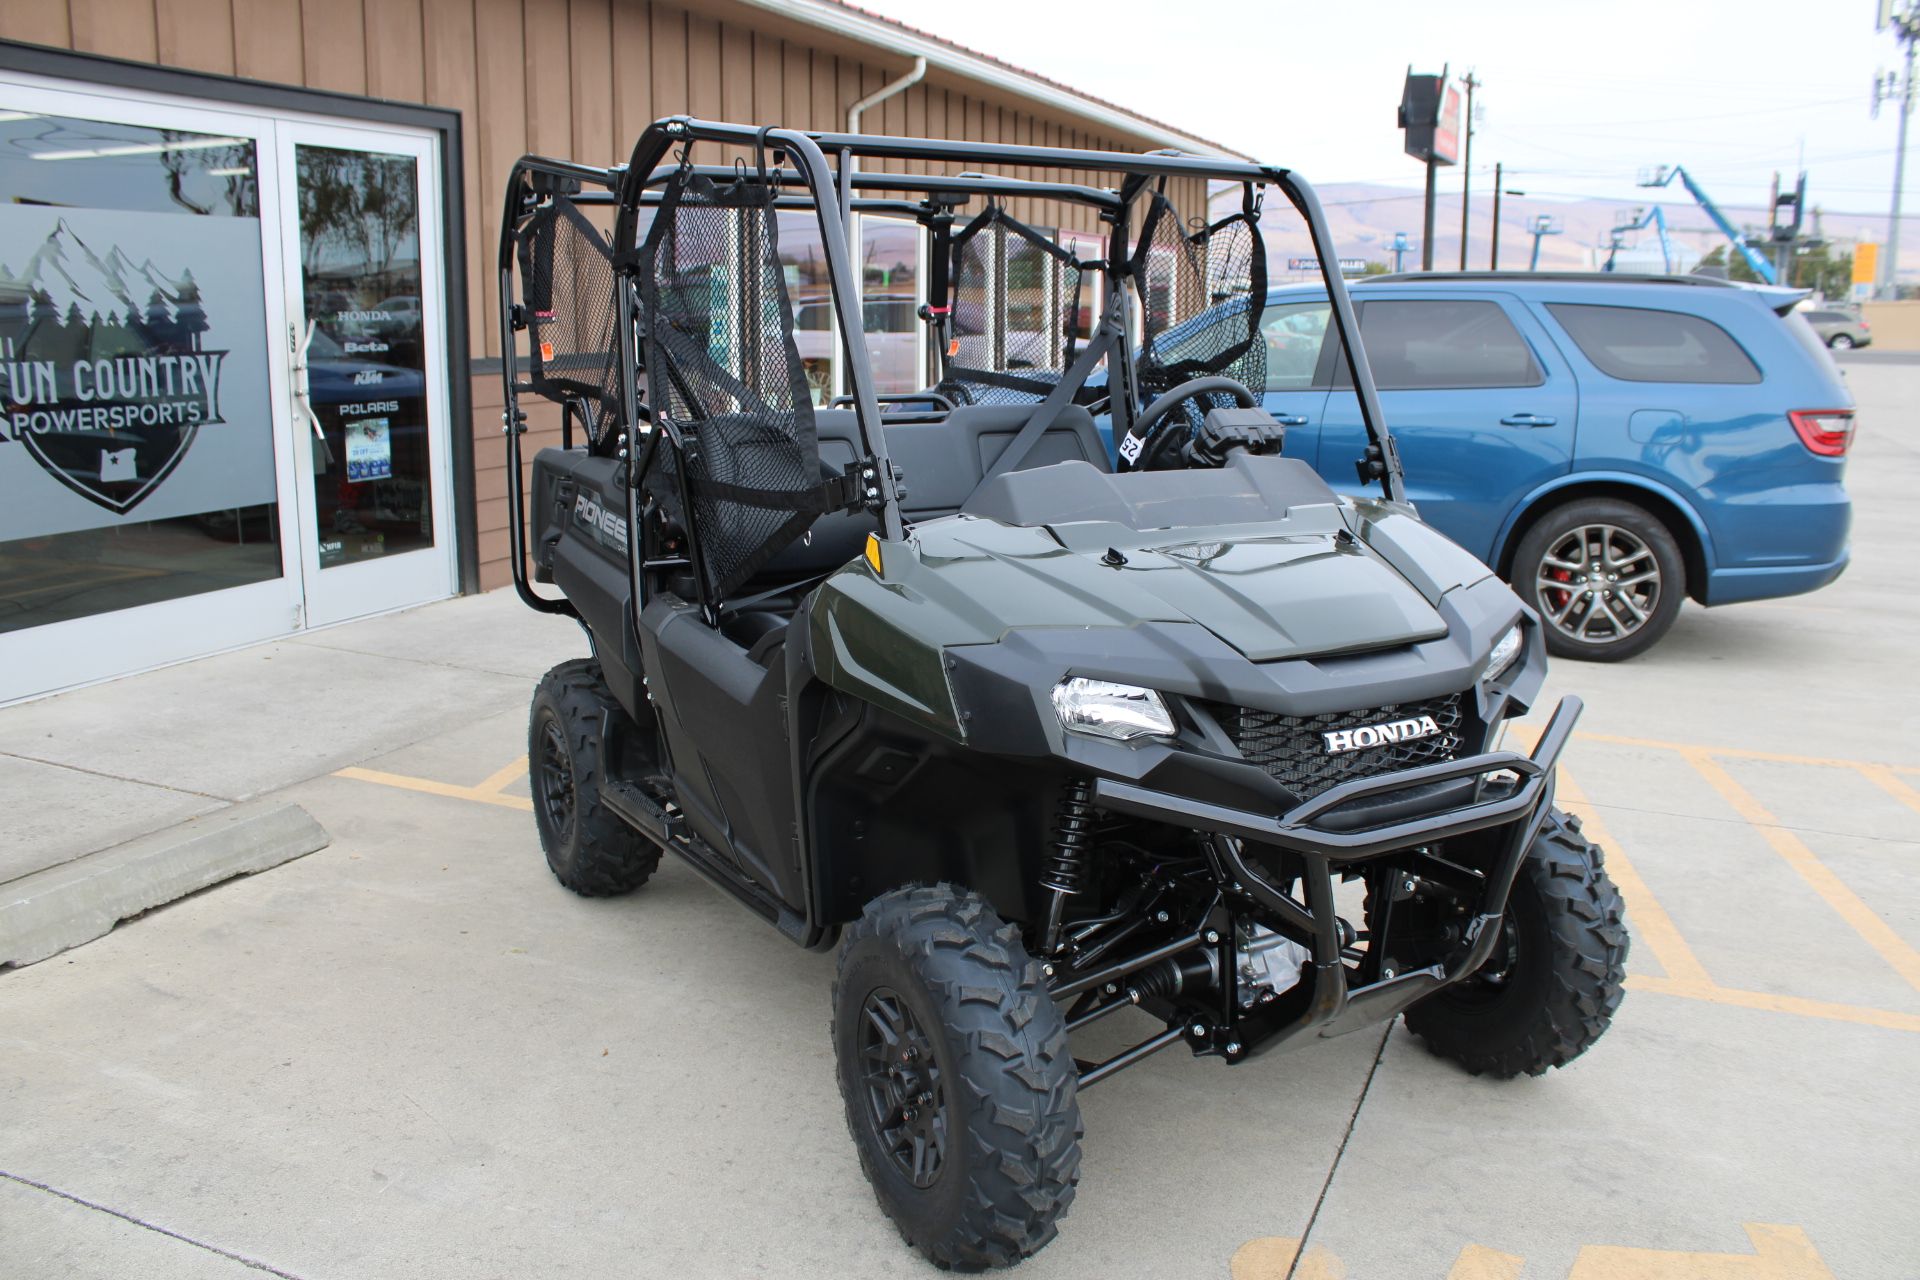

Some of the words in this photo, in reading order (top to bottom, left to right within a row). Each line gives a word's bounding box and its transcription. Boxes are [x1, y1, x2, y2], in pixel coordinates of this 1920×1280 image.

[337, 310, 391, 321] HONDA
[344, 342, 389, 353] Beta
[0, 361, 60, 406] UN
[73, 354, 221, 420] COUNTRY
[353, 369, 383, 386] KTM
[13, 401, 201, 436] POWERSPORTS
[339, 400, 400, 416] POLARIS
[574, 494, 628, 546] PIONEE
[1323, 715, 1442, 754] HONDA
